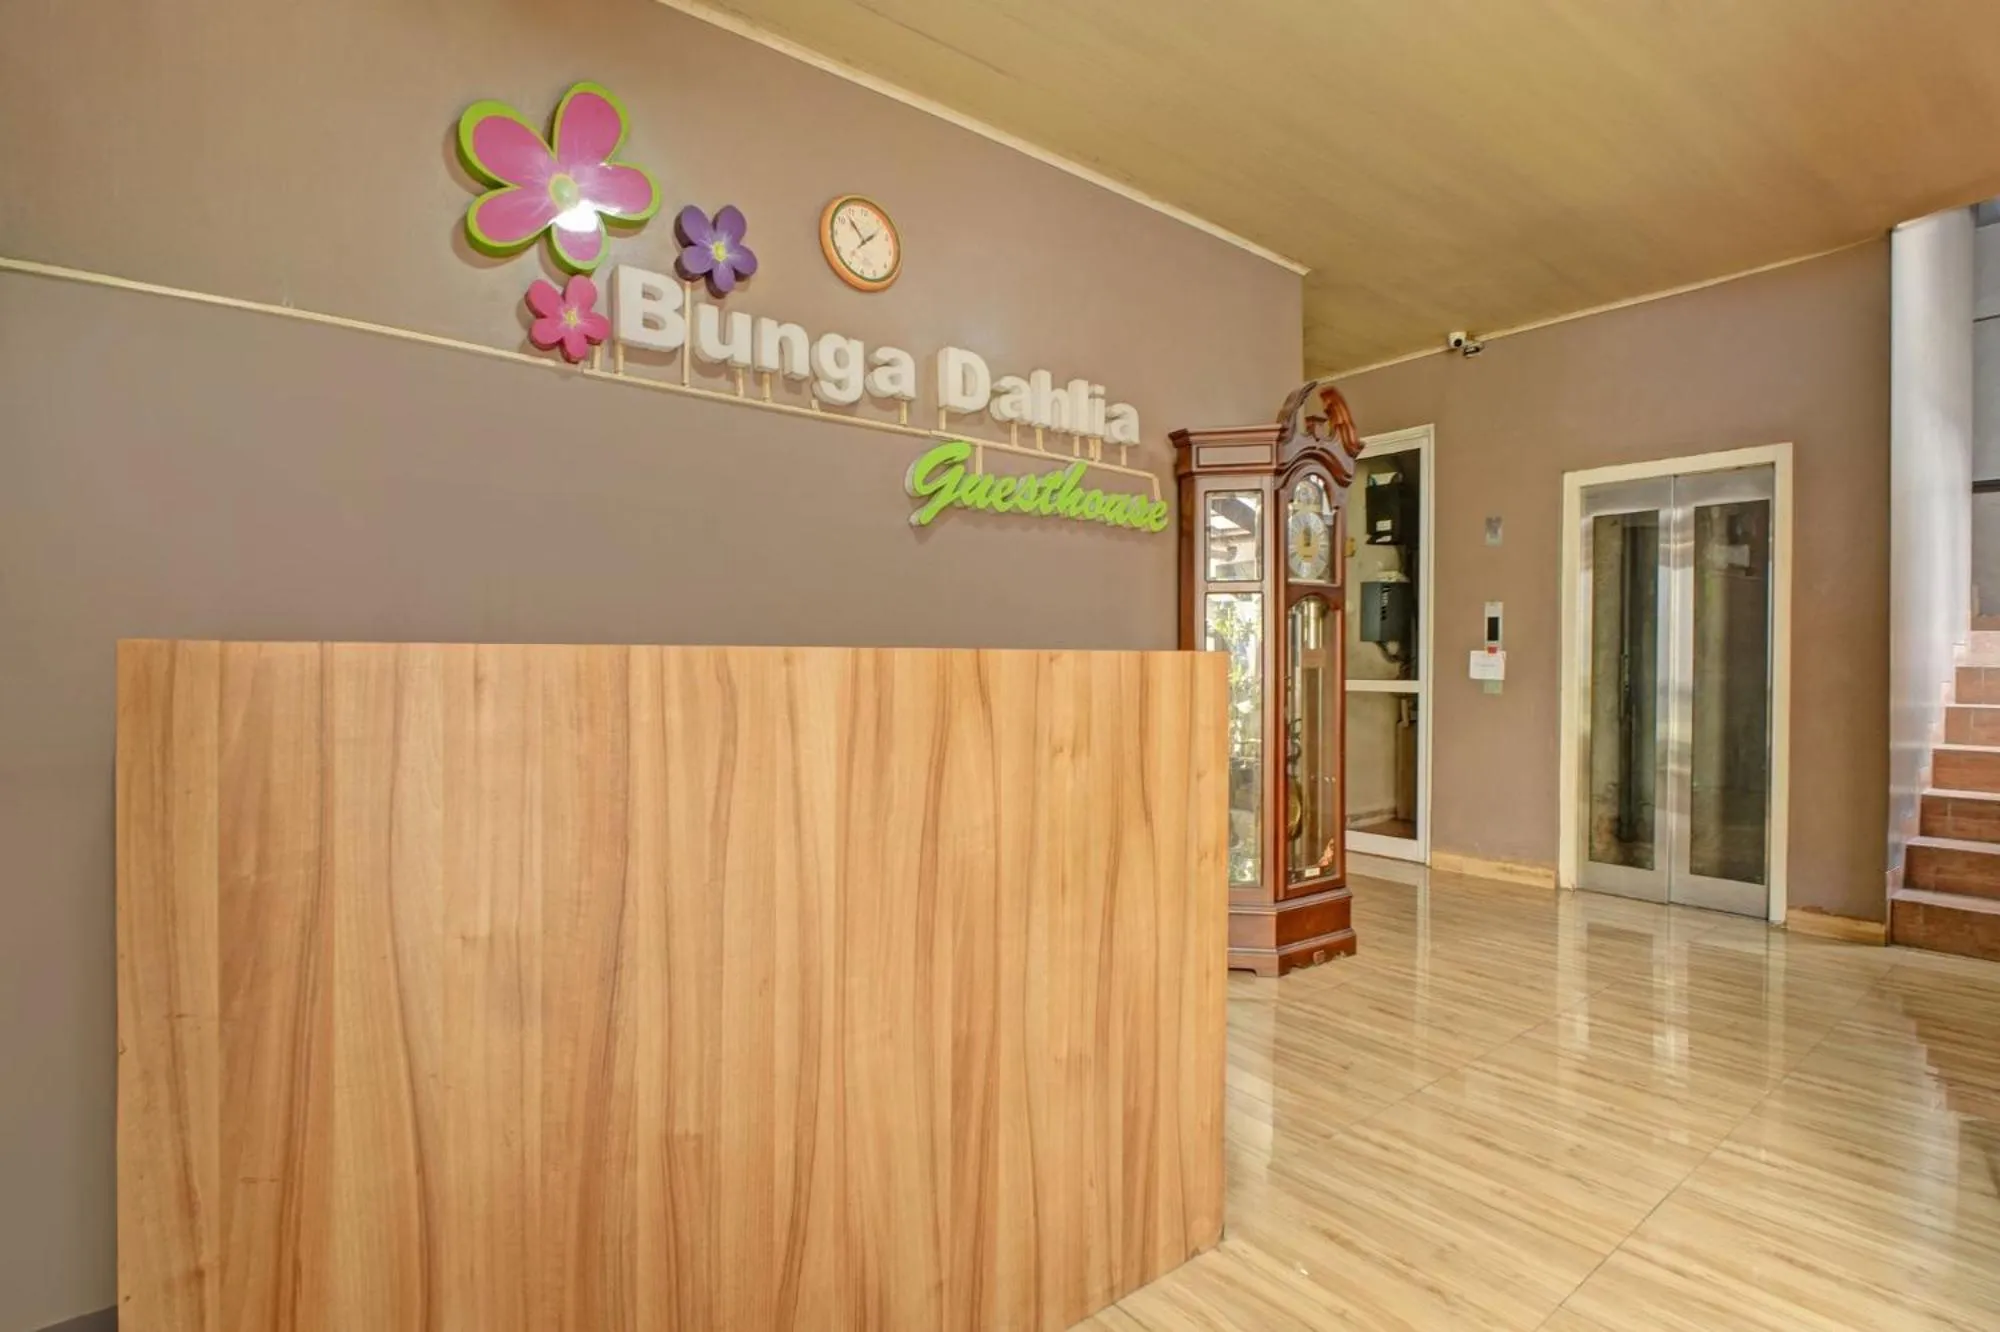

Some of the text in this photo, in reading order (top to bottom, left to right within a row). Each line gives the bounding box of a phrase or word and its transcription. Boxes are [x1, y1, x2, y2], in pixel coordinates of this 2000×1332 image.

[613, 264, 1140, 445] Bunga Dahlia
[905, 441, 1169, 533] Guesthouse
